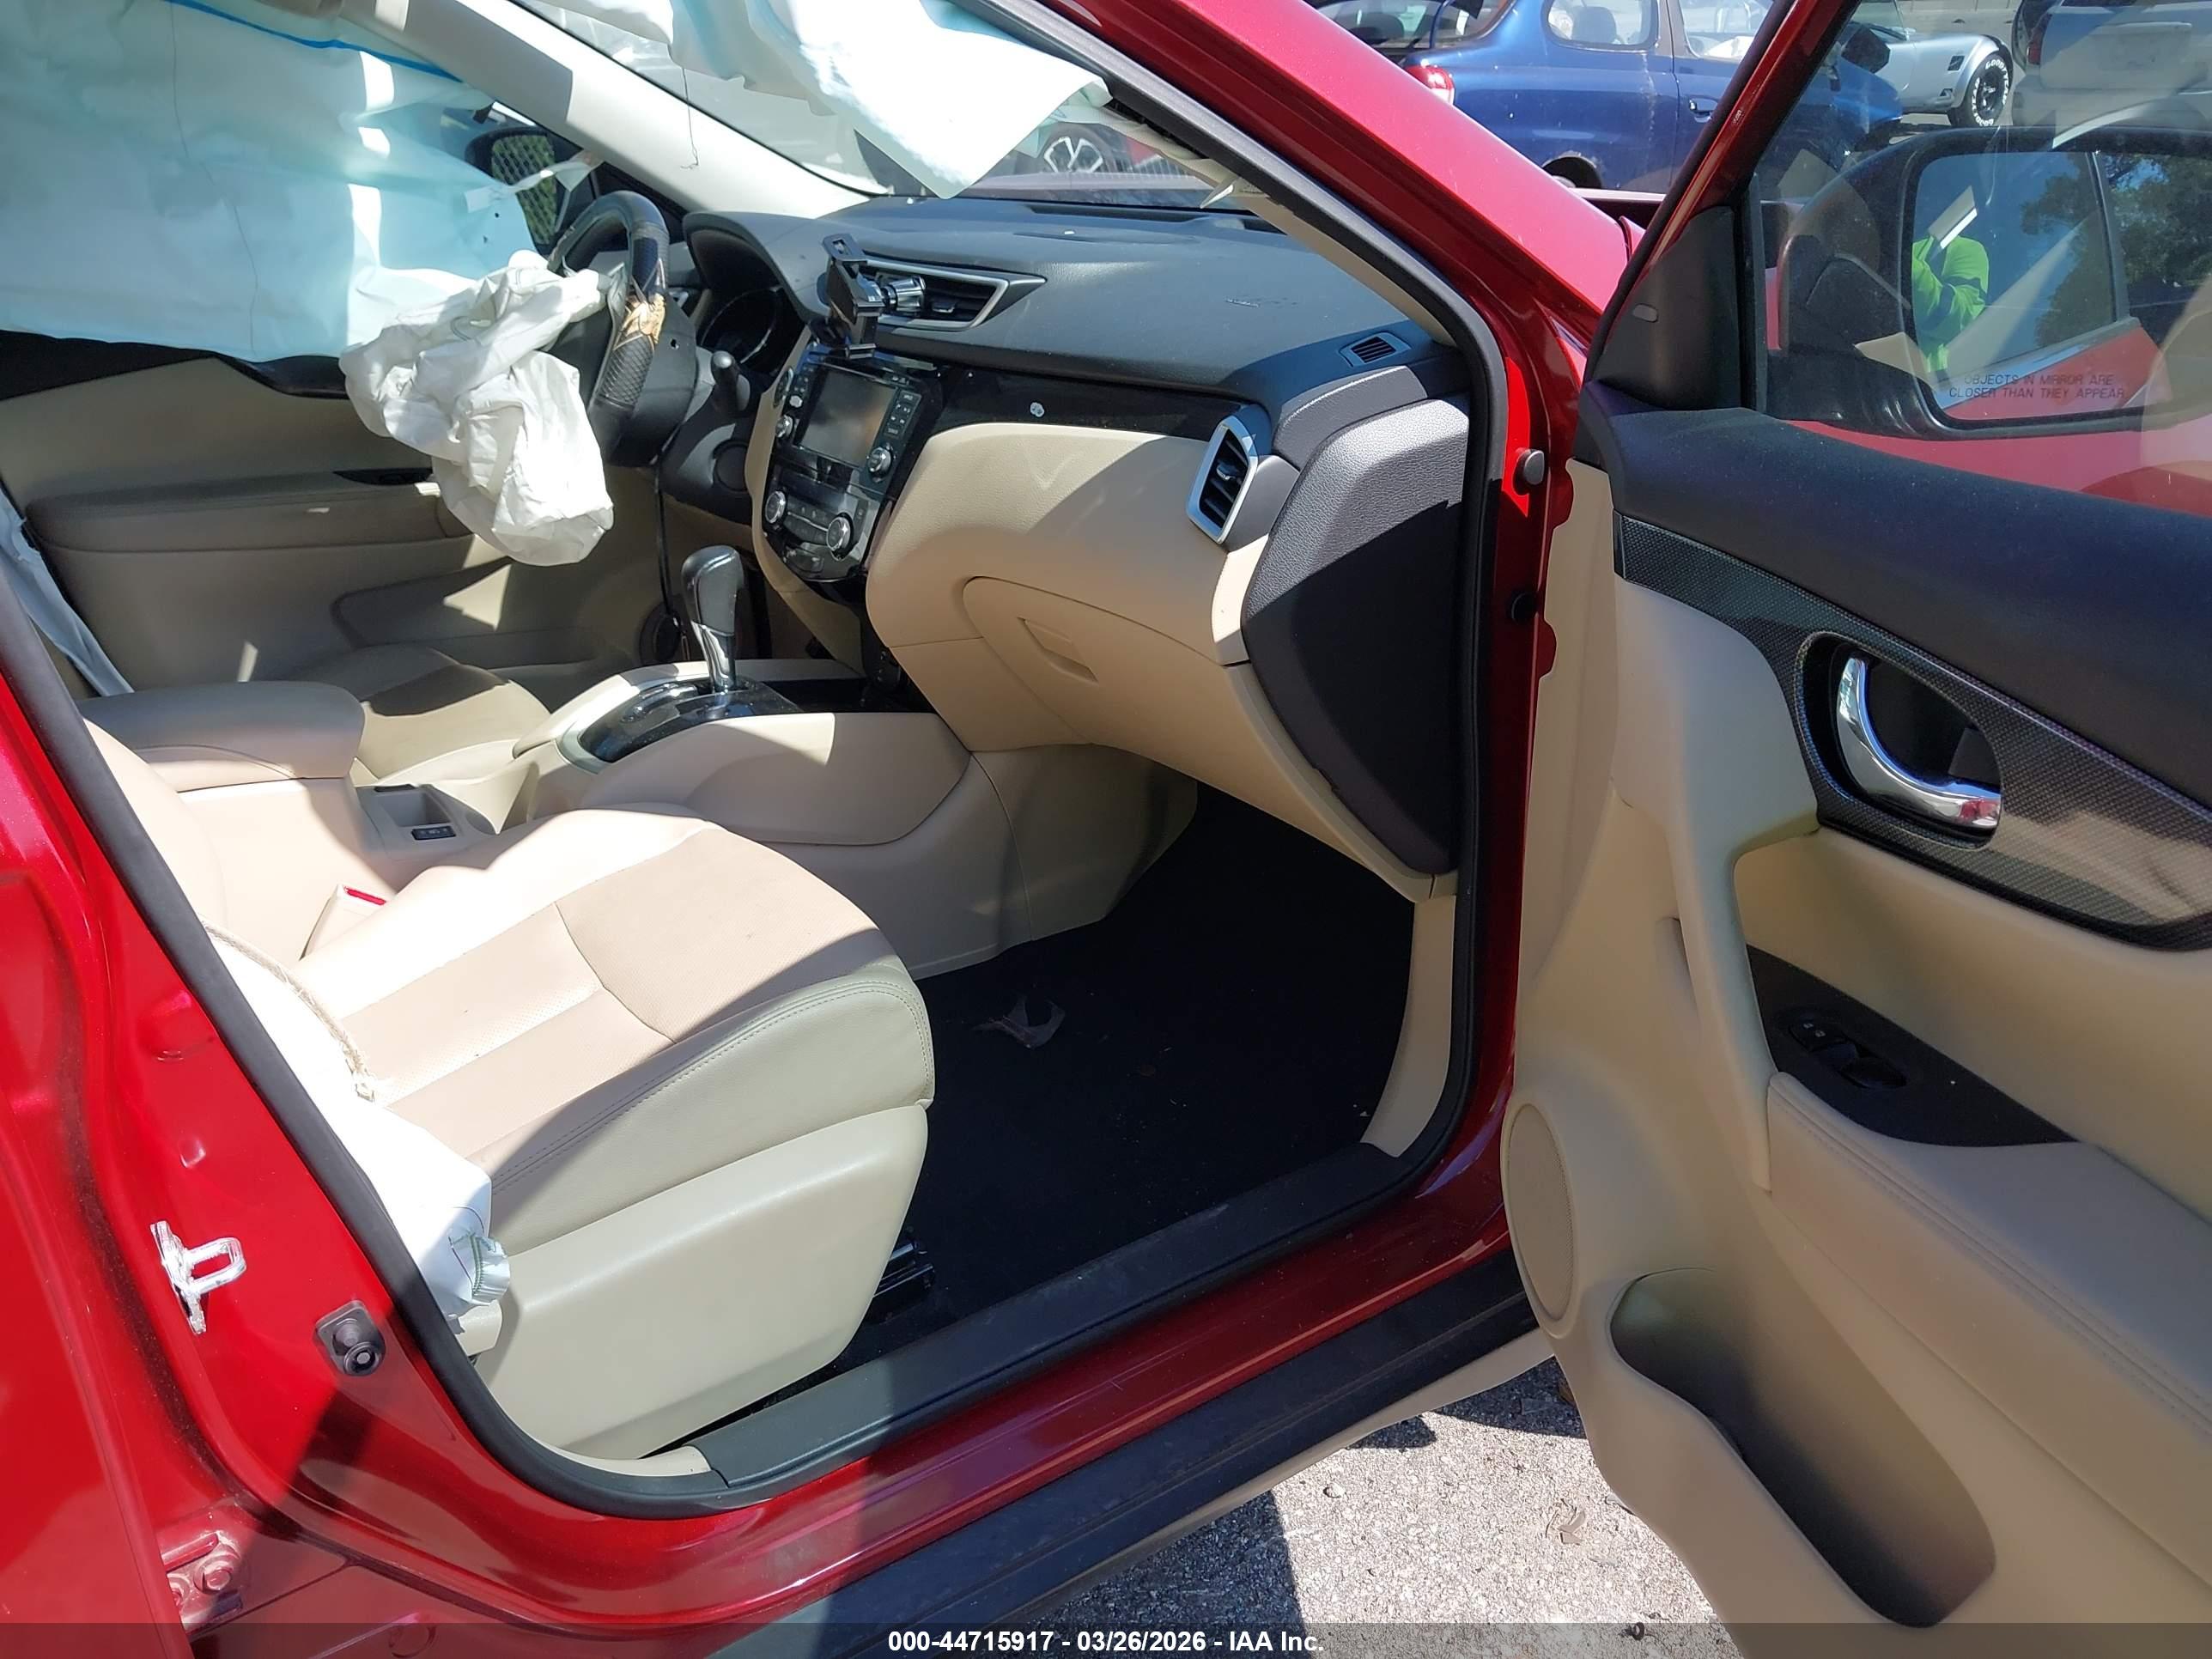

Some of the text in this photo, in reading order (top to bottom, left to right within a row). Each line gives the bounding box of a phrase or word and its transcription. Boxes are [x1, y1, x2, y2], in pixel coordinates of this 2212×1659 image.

[1984, 59, 2009, 105] GOODYEAR
[1964, 374, 2115, 385] OBJECTS IN MIRROR ARE
[1949, 387, 2124, 399] CLOSER THAN THEY APPEAR
